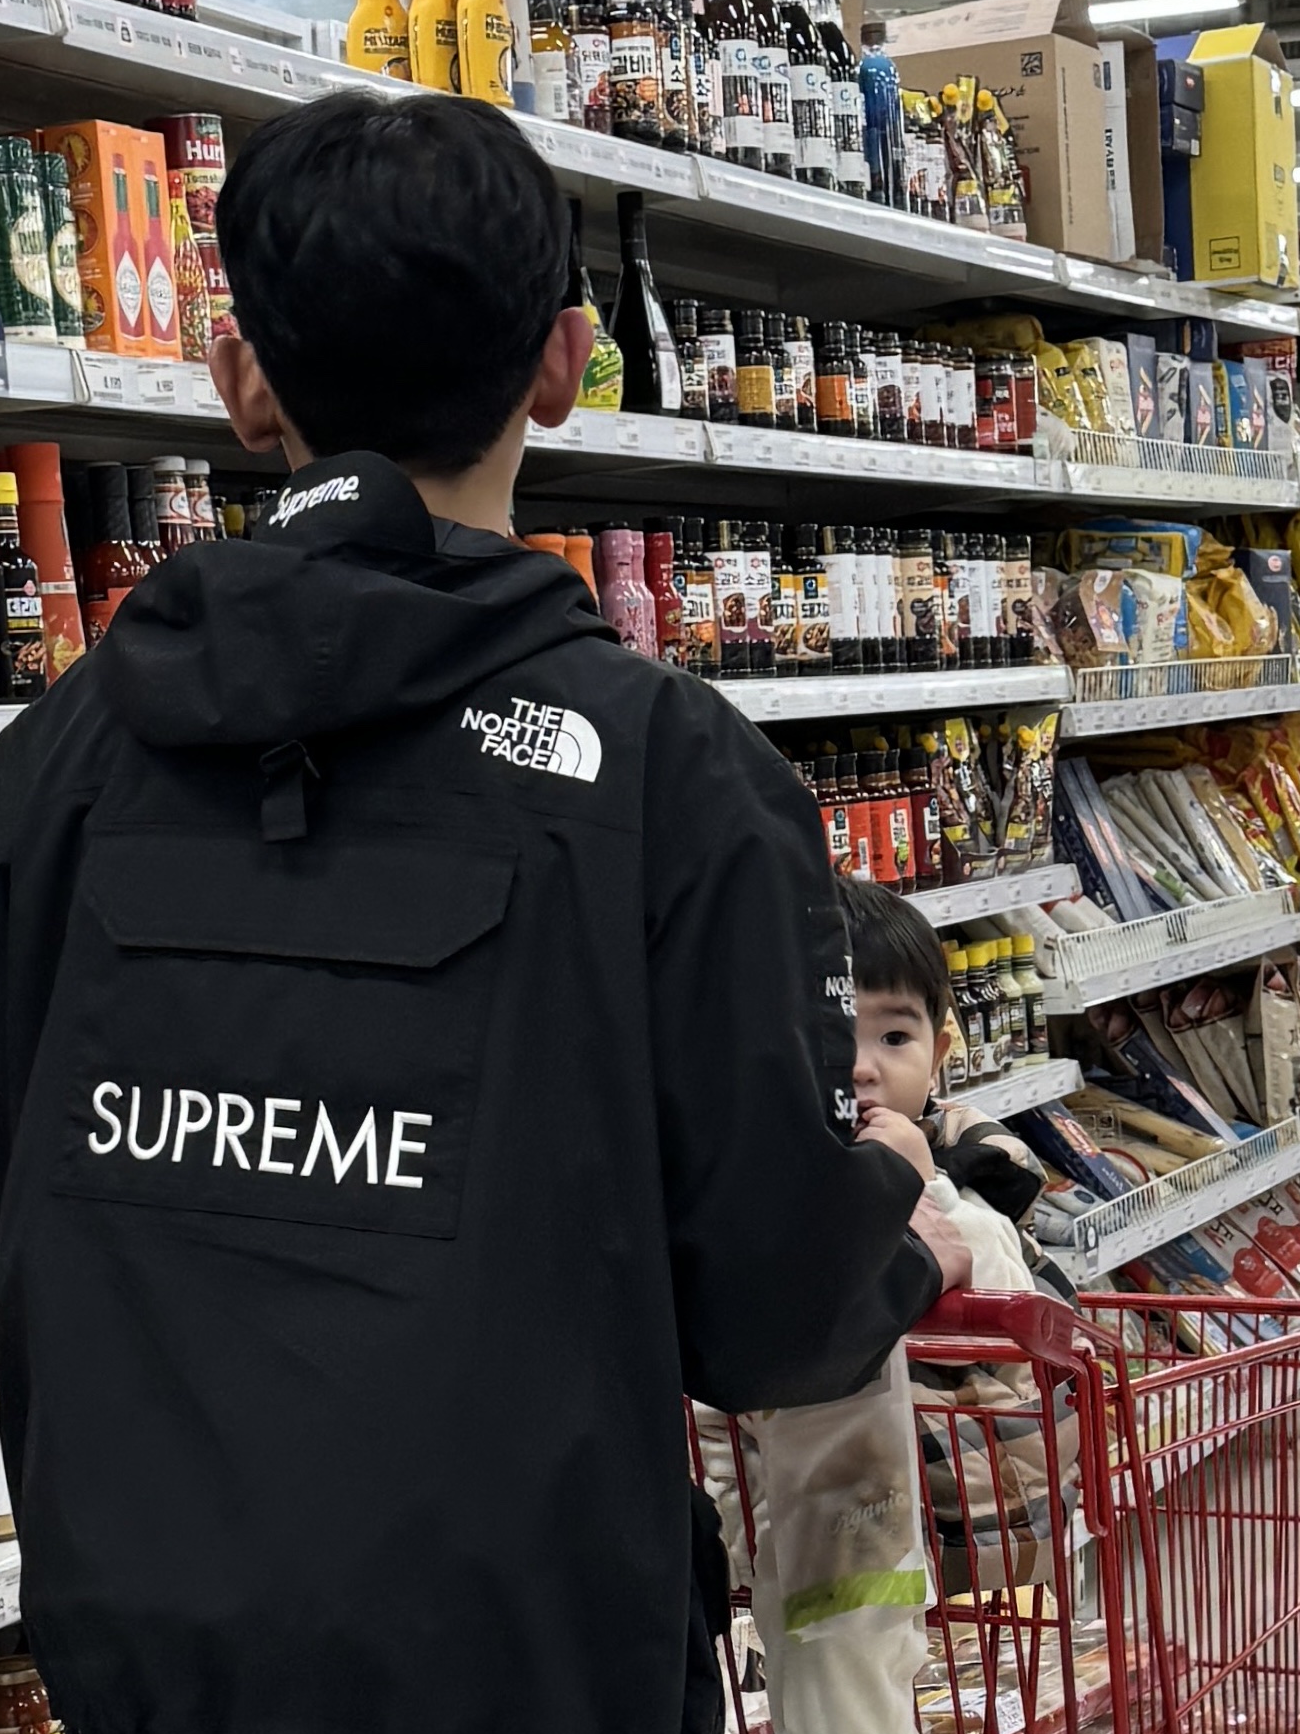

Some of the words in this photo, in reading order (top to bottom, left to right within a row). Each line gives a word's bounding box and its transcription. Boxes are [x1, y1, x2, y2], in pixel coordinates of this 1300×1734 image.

[461, 706, 557, 753] NORTH
[510, 697, 562, 728] THE
[478, 736, 550, 772] FACE
[88, 1081, 434, 1190] SUPREME
